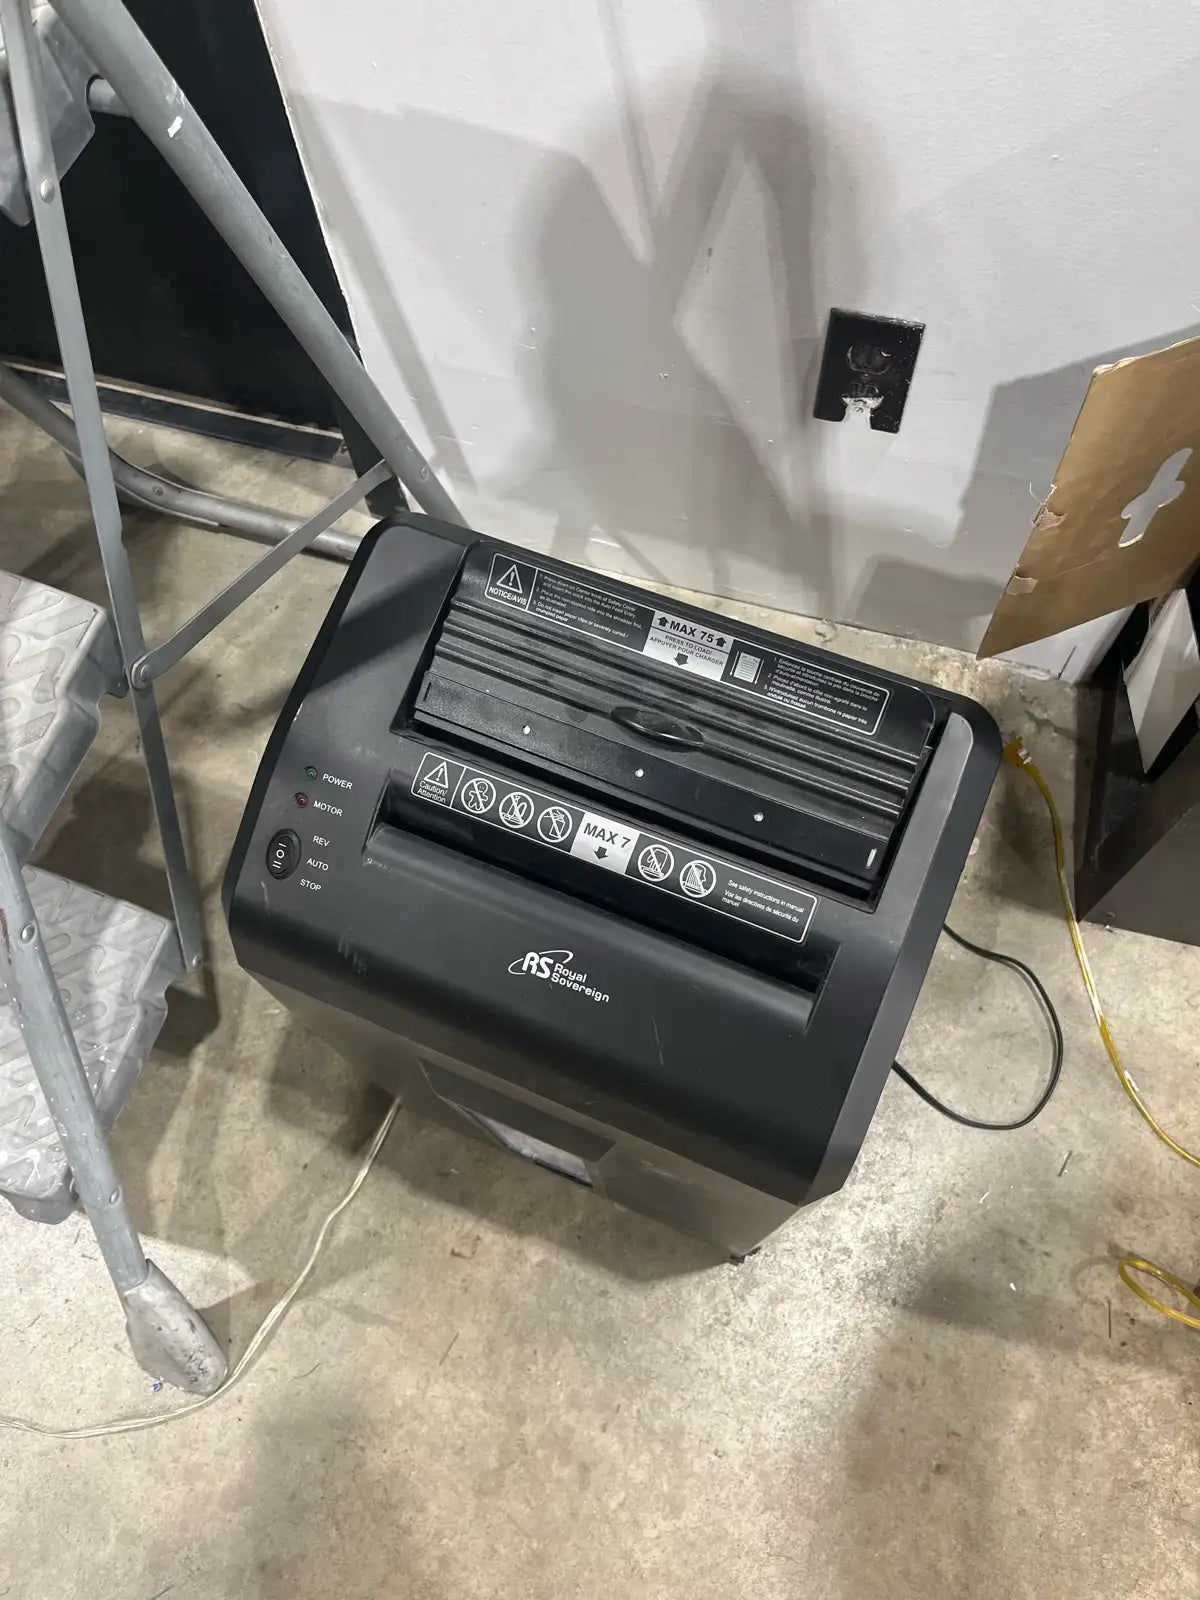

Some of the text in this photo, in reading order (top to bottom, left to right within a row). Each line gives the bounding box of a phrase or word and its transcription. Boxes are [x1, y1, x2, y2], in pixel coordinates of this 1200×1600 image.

[488, 586, 527, 606] NOTICE/AVIS
[622, 603, 636, 611] Cover
[564, 612, 577, 620] paper
[670, 620, 714, 643] MAX 75
[665, 635, 683, 646] PRESS
[649, 636, 723, 666] APPUYER POUR CHARGER
[806, 668, 822, 677] touche
[799, 697, 813, 705] aucun
[814, 702, 837, 713] trombone
[322, 774, 352, 789] POWER
[420, 781, 448, 796] Caution/
[417, 788, 446, 803] Attention
[313, 800, 343, 816] MOTOR
[313, 836, 330, 847] REV
[584, 823, 631, 848] MAX 7
[307, 858, 328, 870] AUTO
[300, 879, 321, 891] STOP
[727, 879, 738, 888] See
[738, 884, 753, 894] safety
[753, 890, 780, 904] instructions
[785, 902, 804, 912] manual
[724, 889, 734, 897] Voir
[742, 897, 765, 909] directives
[772, 908, 791, 919] sécurité
[522, 952, 554, 978] RS
[554, 963, 587, 982] Royal
[551, 973, 609, 1002] Sovereign
